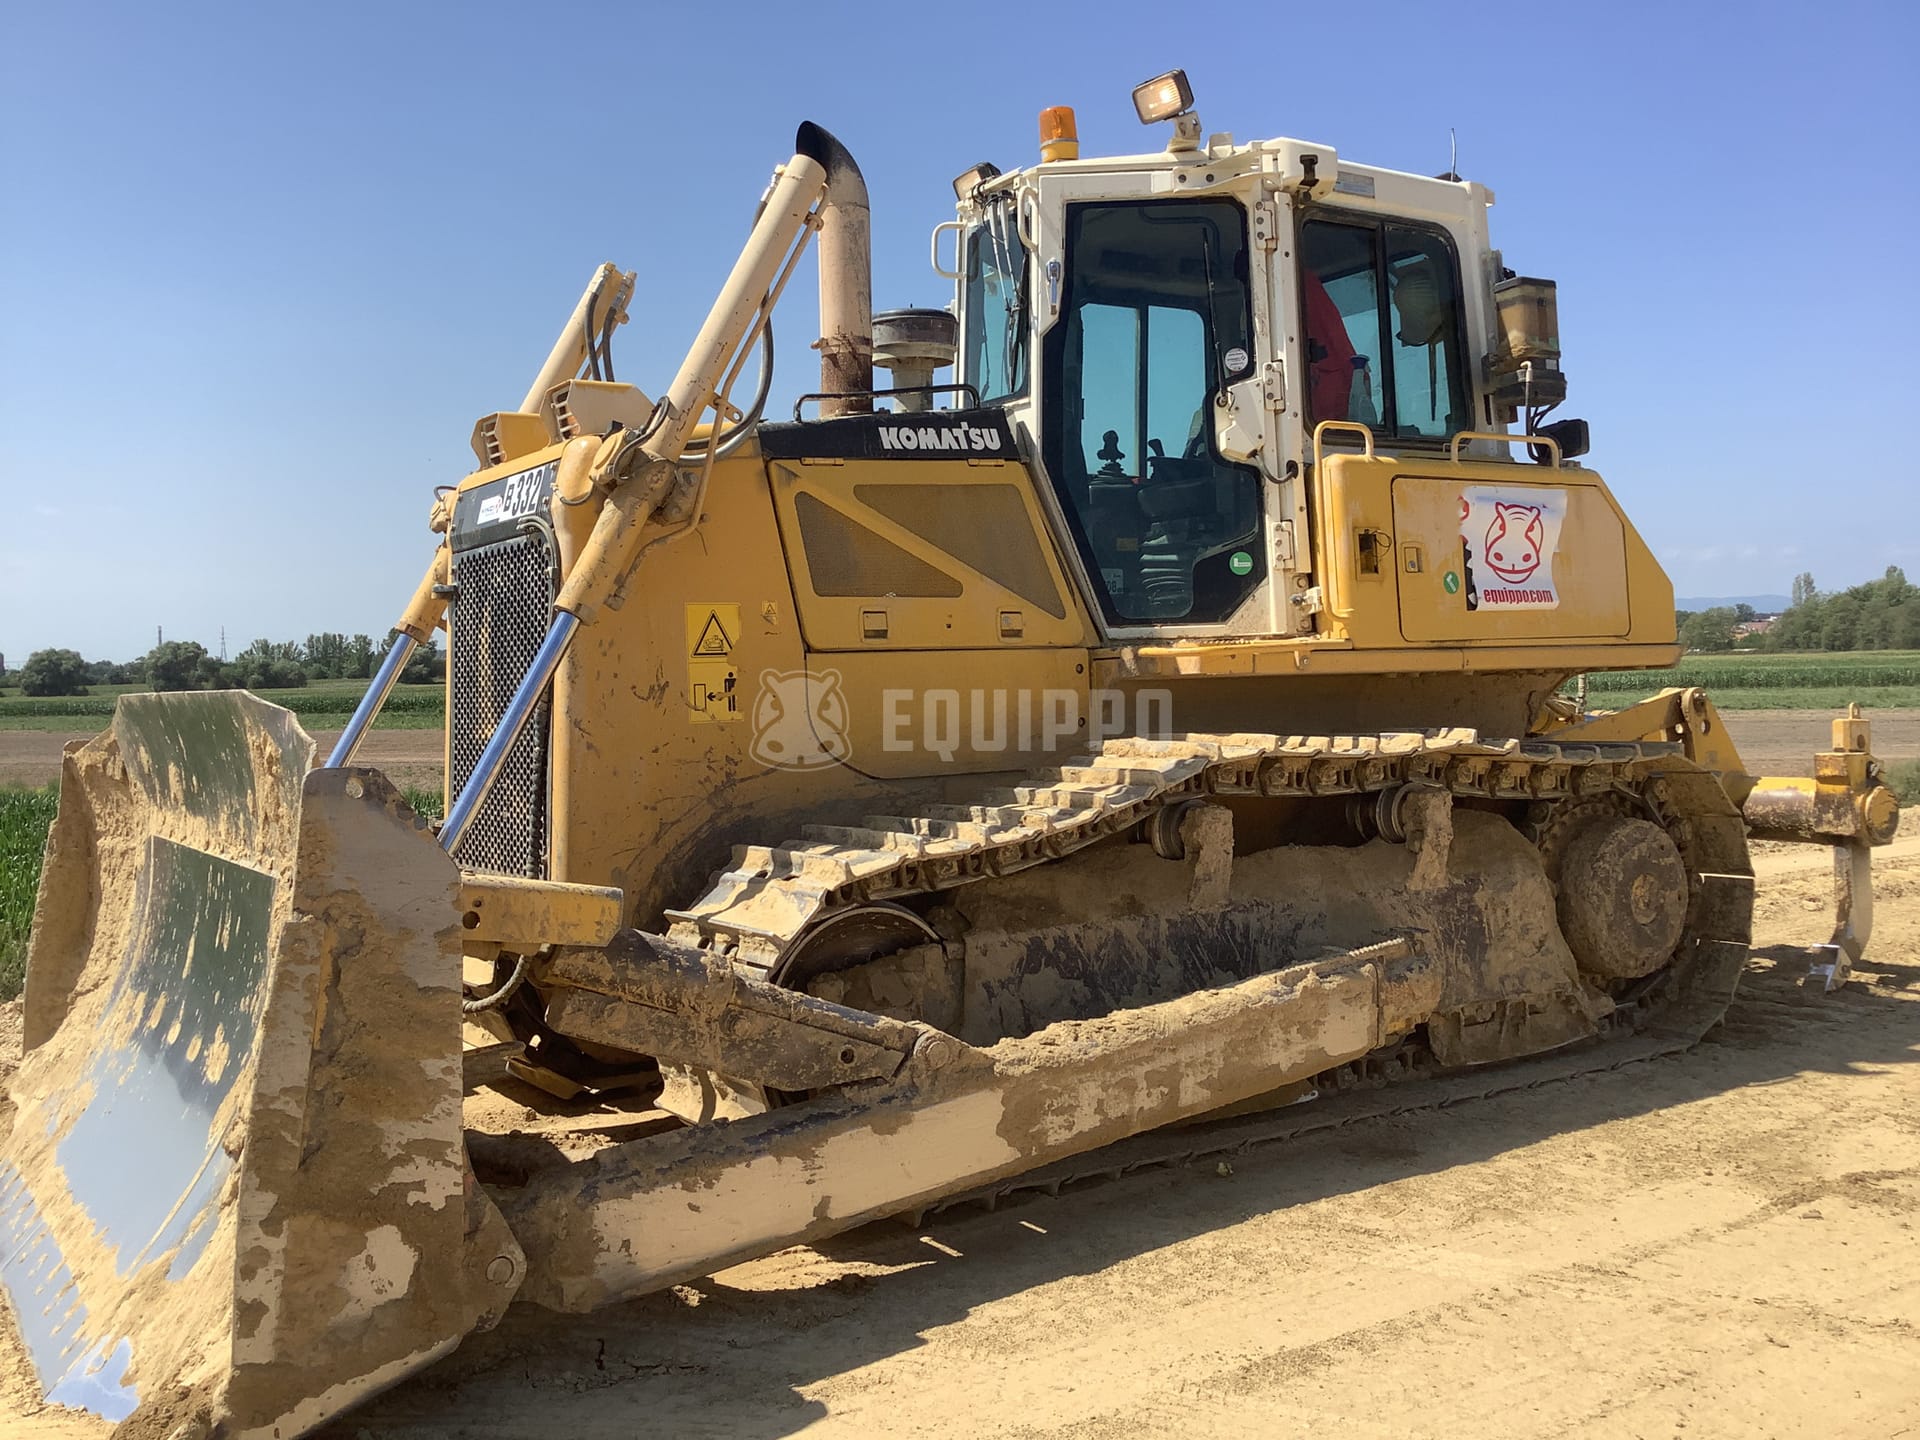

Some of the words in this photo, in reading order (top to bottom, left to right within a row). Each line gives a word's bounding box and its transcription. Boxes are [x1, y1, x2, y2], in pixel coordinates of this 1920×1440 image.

[878, 421, 1001, 450] KOMATSU
[503, 469, 543, 516] B332
[1483, 587, 1553, 604] equippo.com
